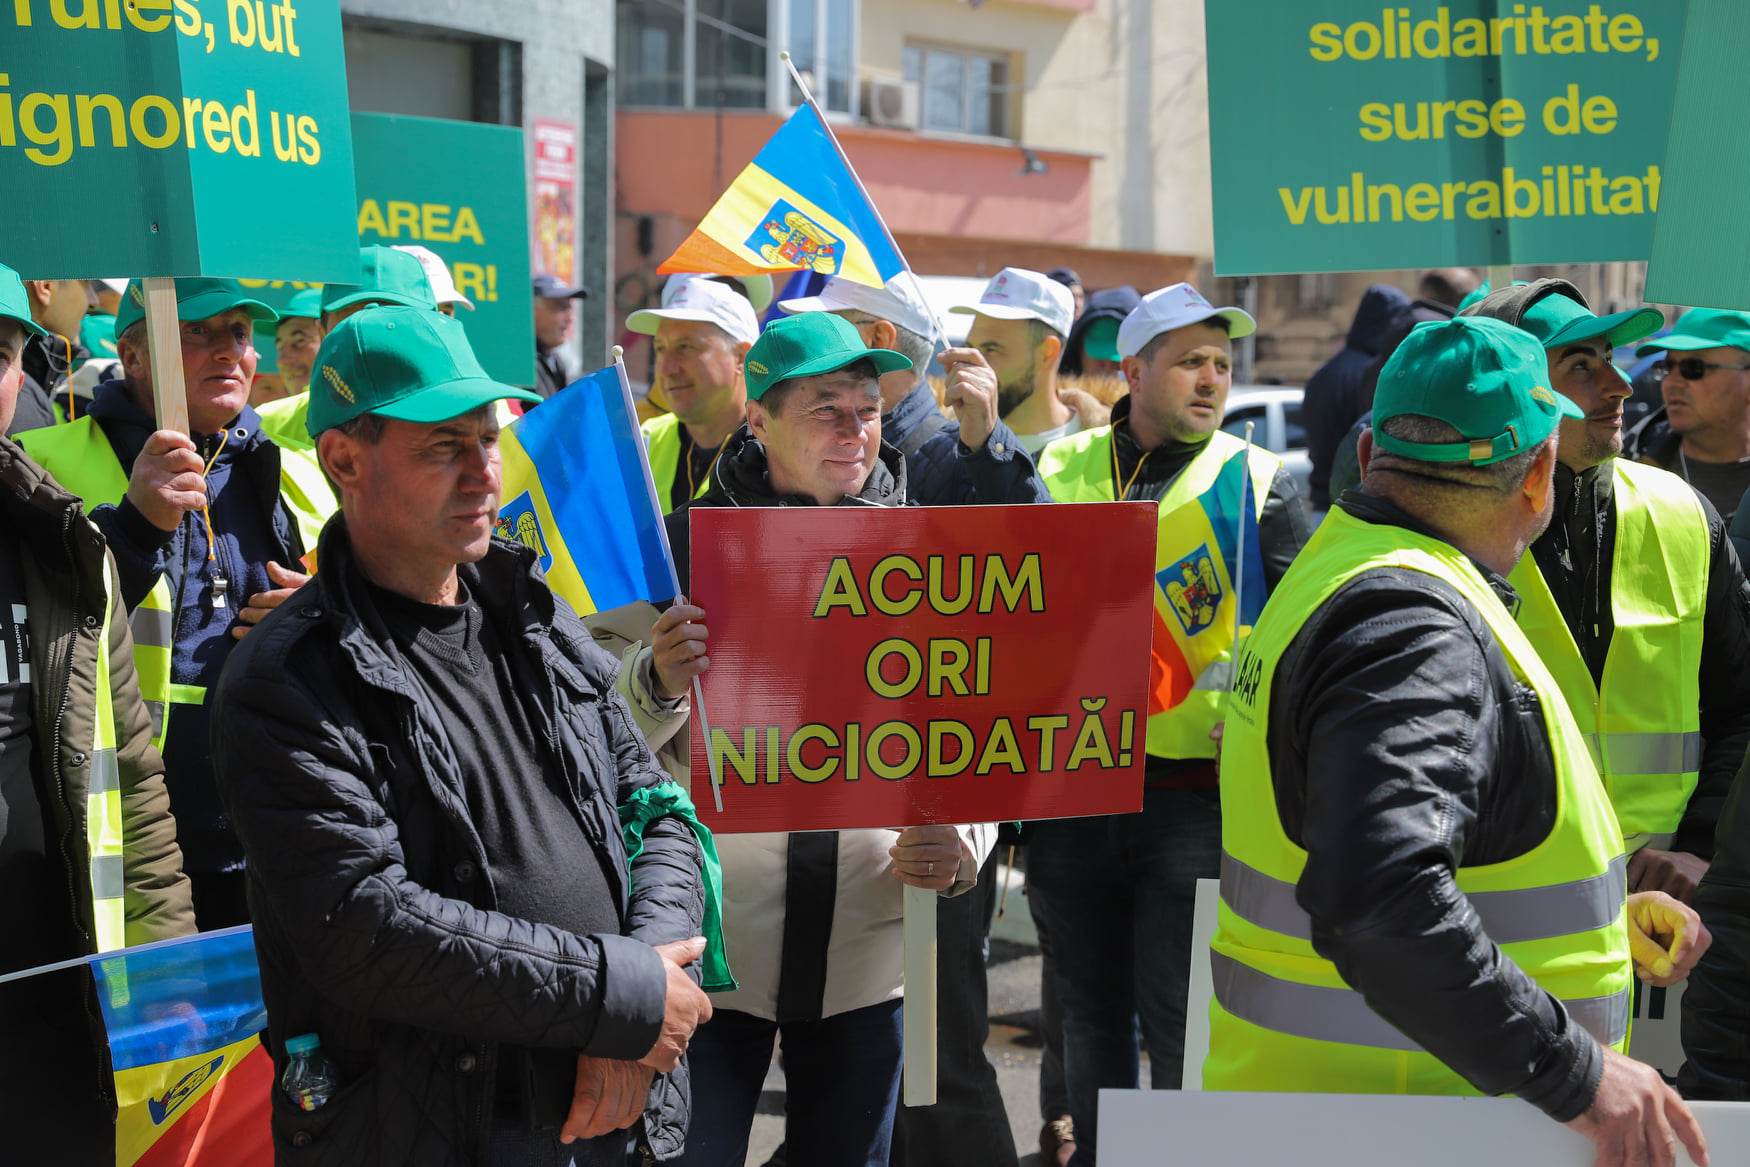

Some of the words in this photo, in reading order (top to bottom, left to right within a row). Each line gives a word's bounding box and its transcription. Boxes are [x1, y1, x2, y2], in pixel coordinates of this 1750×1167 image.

[227, 0, 300, 57] but
[1309, 4, 1660, 62] solidaritate,
[0, 73, 261, 166] ignored
[271, 111, 321, 166] us
[1358, 98, 1526, 142] surse
[1542, 84, 1618, 135] de
[1278, 165, 1661, 225] vulnerabilitat
[812, 553, 1046, 618] ACUM
[865, 637, 991, 699] ORI
[709, 697, 1136, 786] NICIODATĂ!
